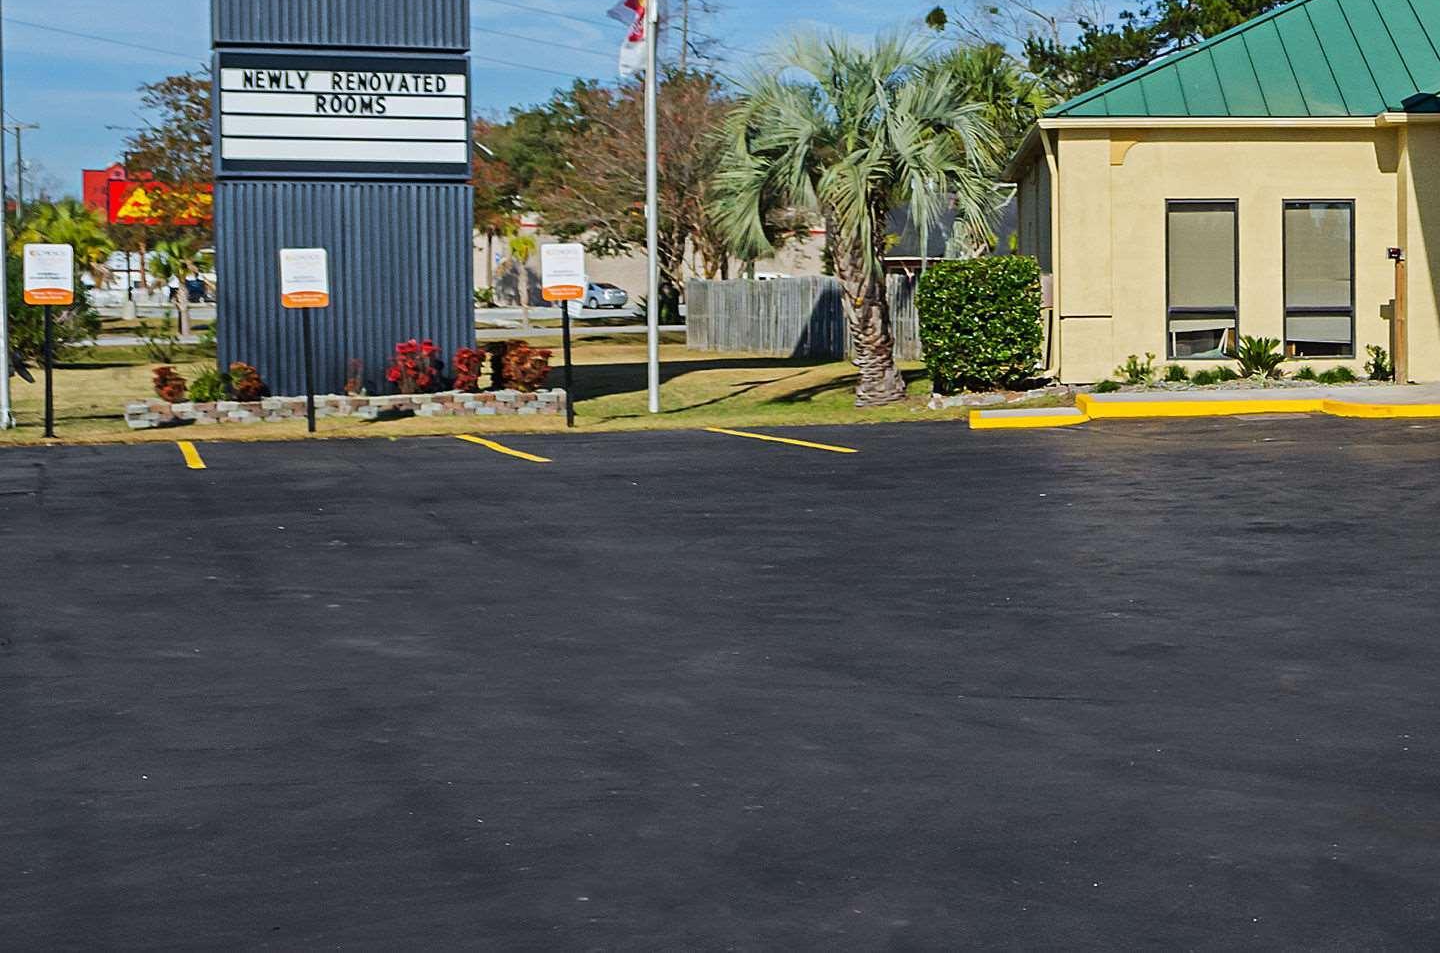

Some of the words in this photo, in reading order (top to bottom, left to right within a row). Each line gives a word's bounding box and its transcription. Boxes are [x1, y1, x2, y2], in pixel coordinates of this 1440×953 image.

[243, 71, 309, 89] NEWLY
[332, 72, 447, 93] RENOVATED
[315, 95, 387, 114] ROOMS
